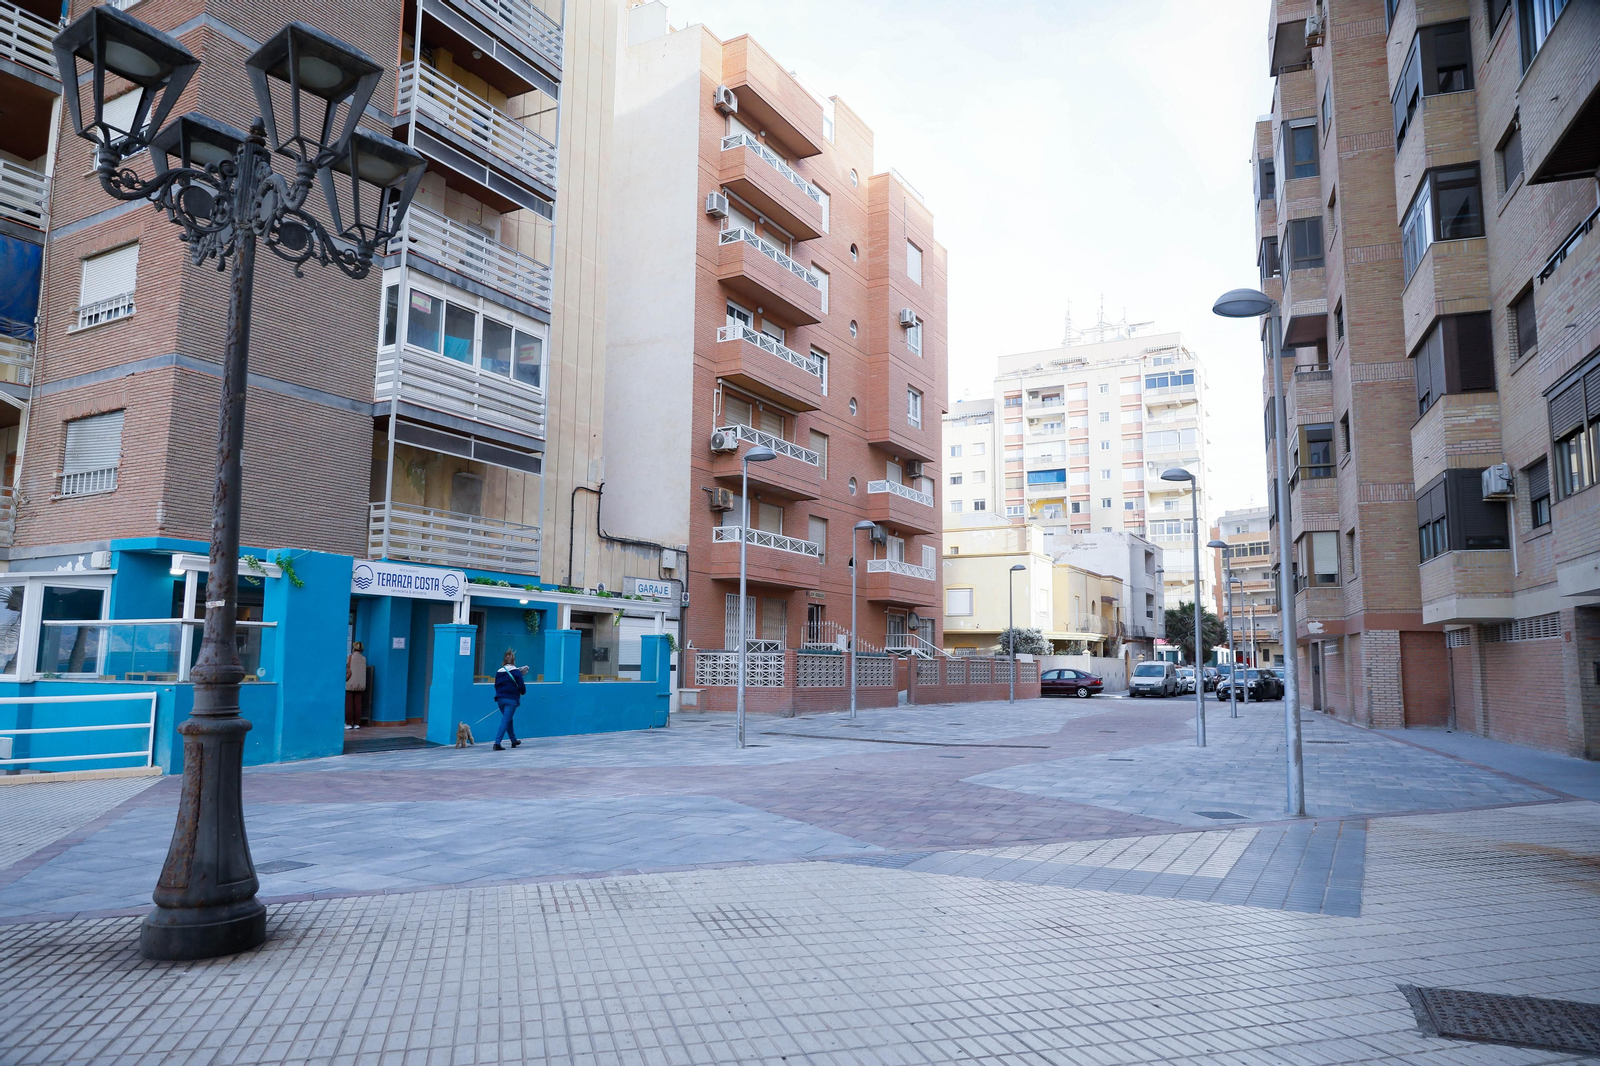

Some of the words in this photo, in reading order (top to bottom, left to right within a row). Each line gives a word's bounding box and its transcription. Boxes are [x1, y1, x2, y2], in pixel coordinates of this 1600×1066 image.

[377, 572, 412, 589] TERRAZA
[414, 576, 440, 591] COSTA
[637, 583, 669, 595] GARAJE
